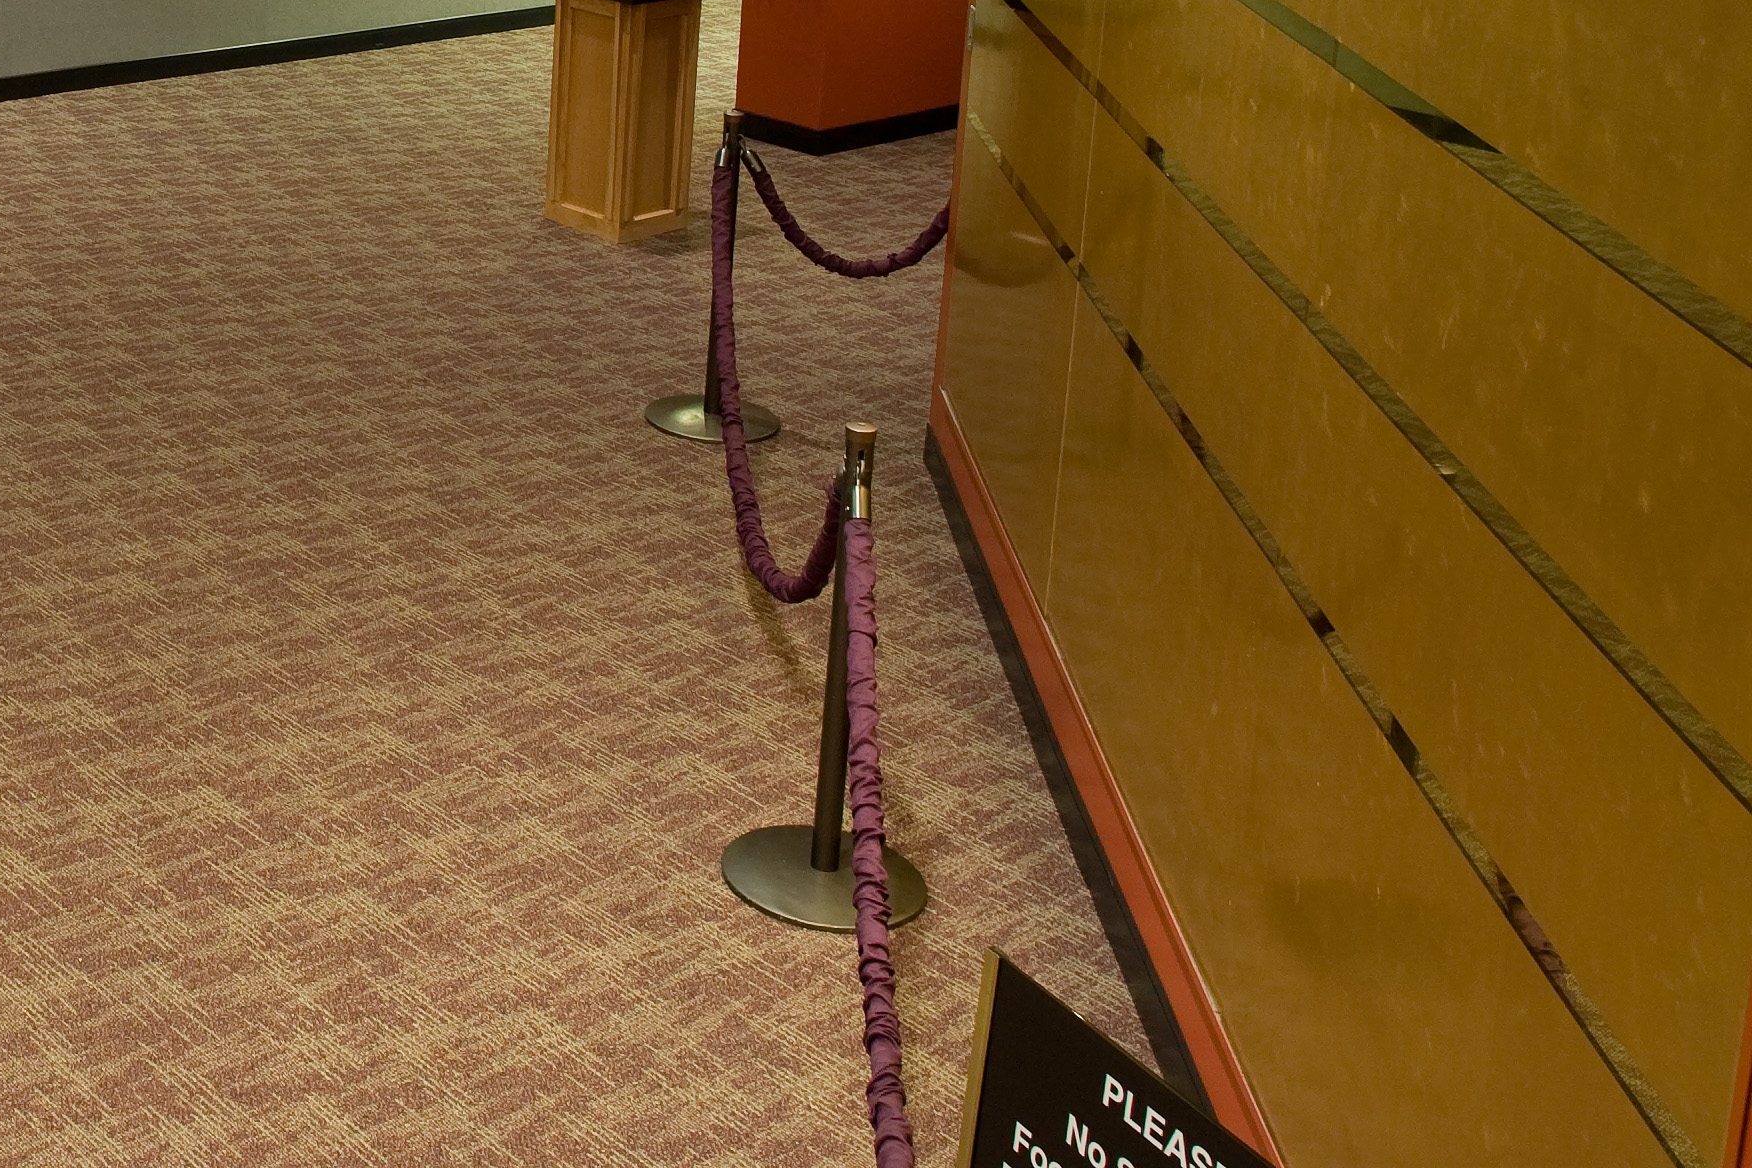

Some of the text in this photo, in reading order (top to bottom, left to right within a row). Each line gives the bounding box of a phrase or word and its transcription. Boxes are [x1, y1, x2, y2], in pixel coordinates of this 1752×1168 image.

[1012, 1120, 1063, 1168] FO
[1065, 1113, 1107, 1168] NO
[1102, 1073, 1226, 1168] PLEAS
